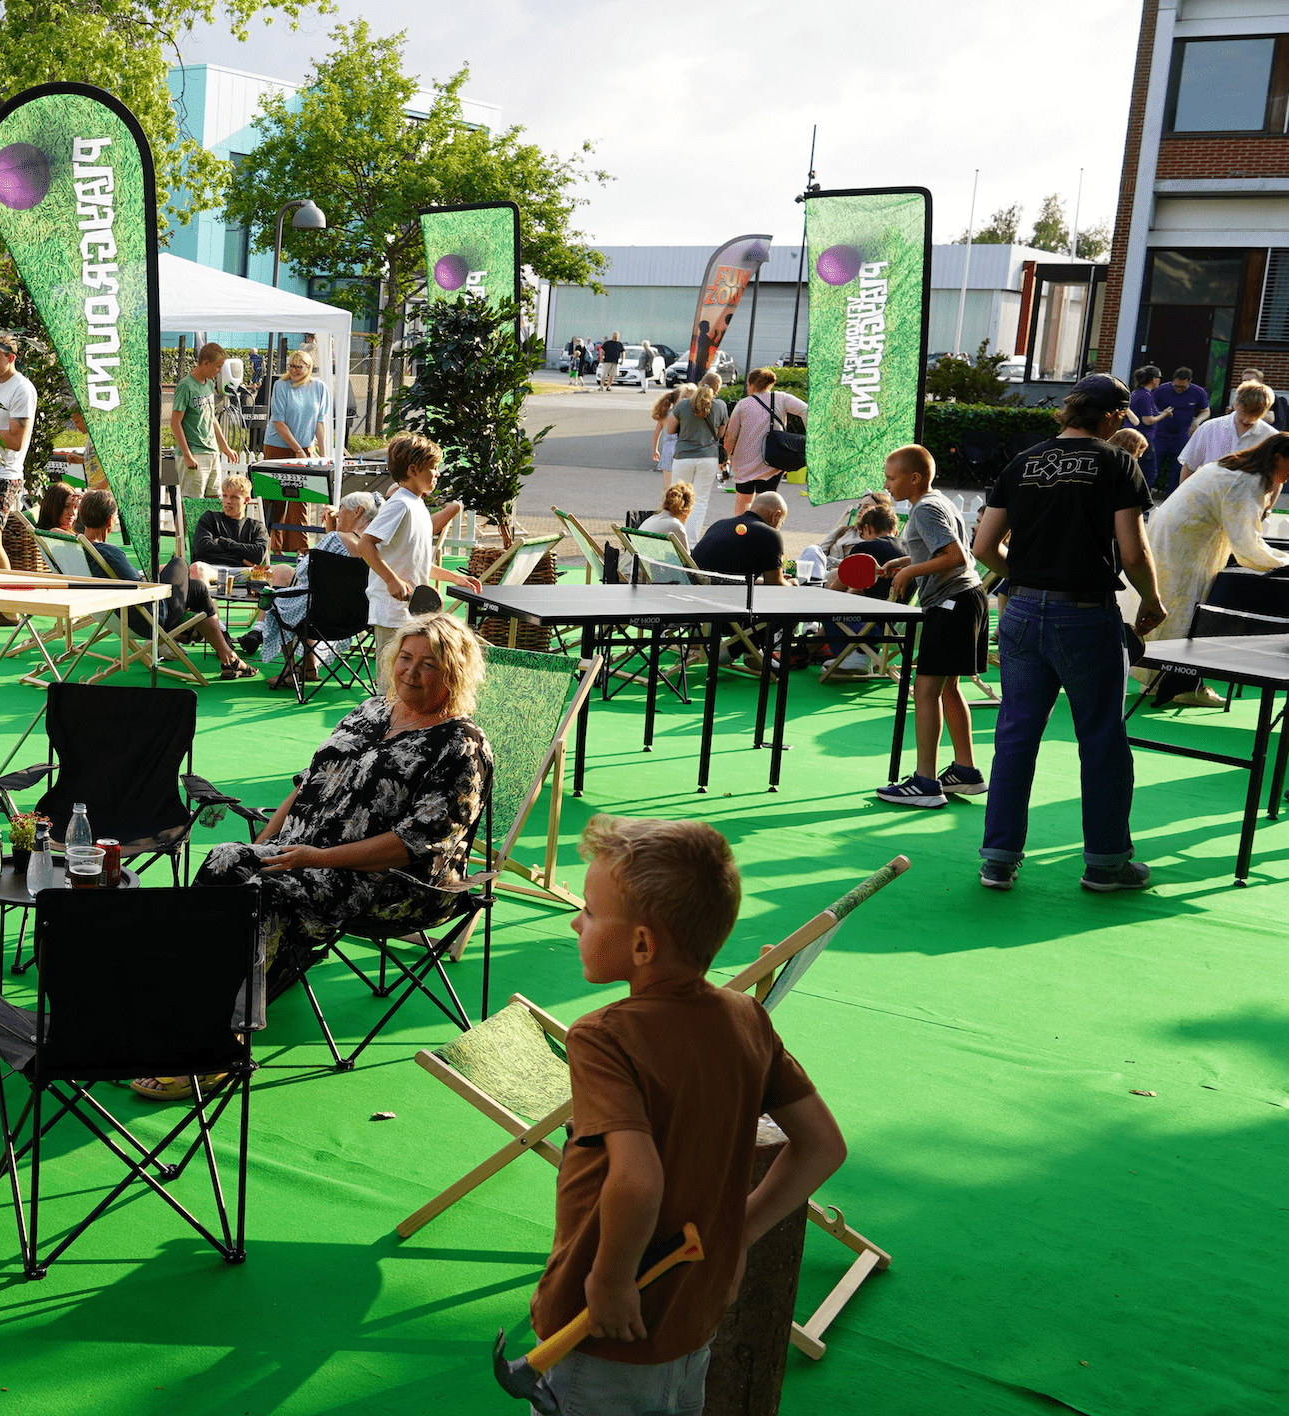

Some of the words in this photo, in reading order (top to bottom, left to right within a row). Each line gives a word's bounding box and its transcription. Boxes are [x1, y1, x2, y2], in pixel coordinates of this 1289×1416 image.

[715, 265, 752, 289] FUN
[641, 616, 660, 624] HOOD
[1174, 666, 1197, 676] HOOD
